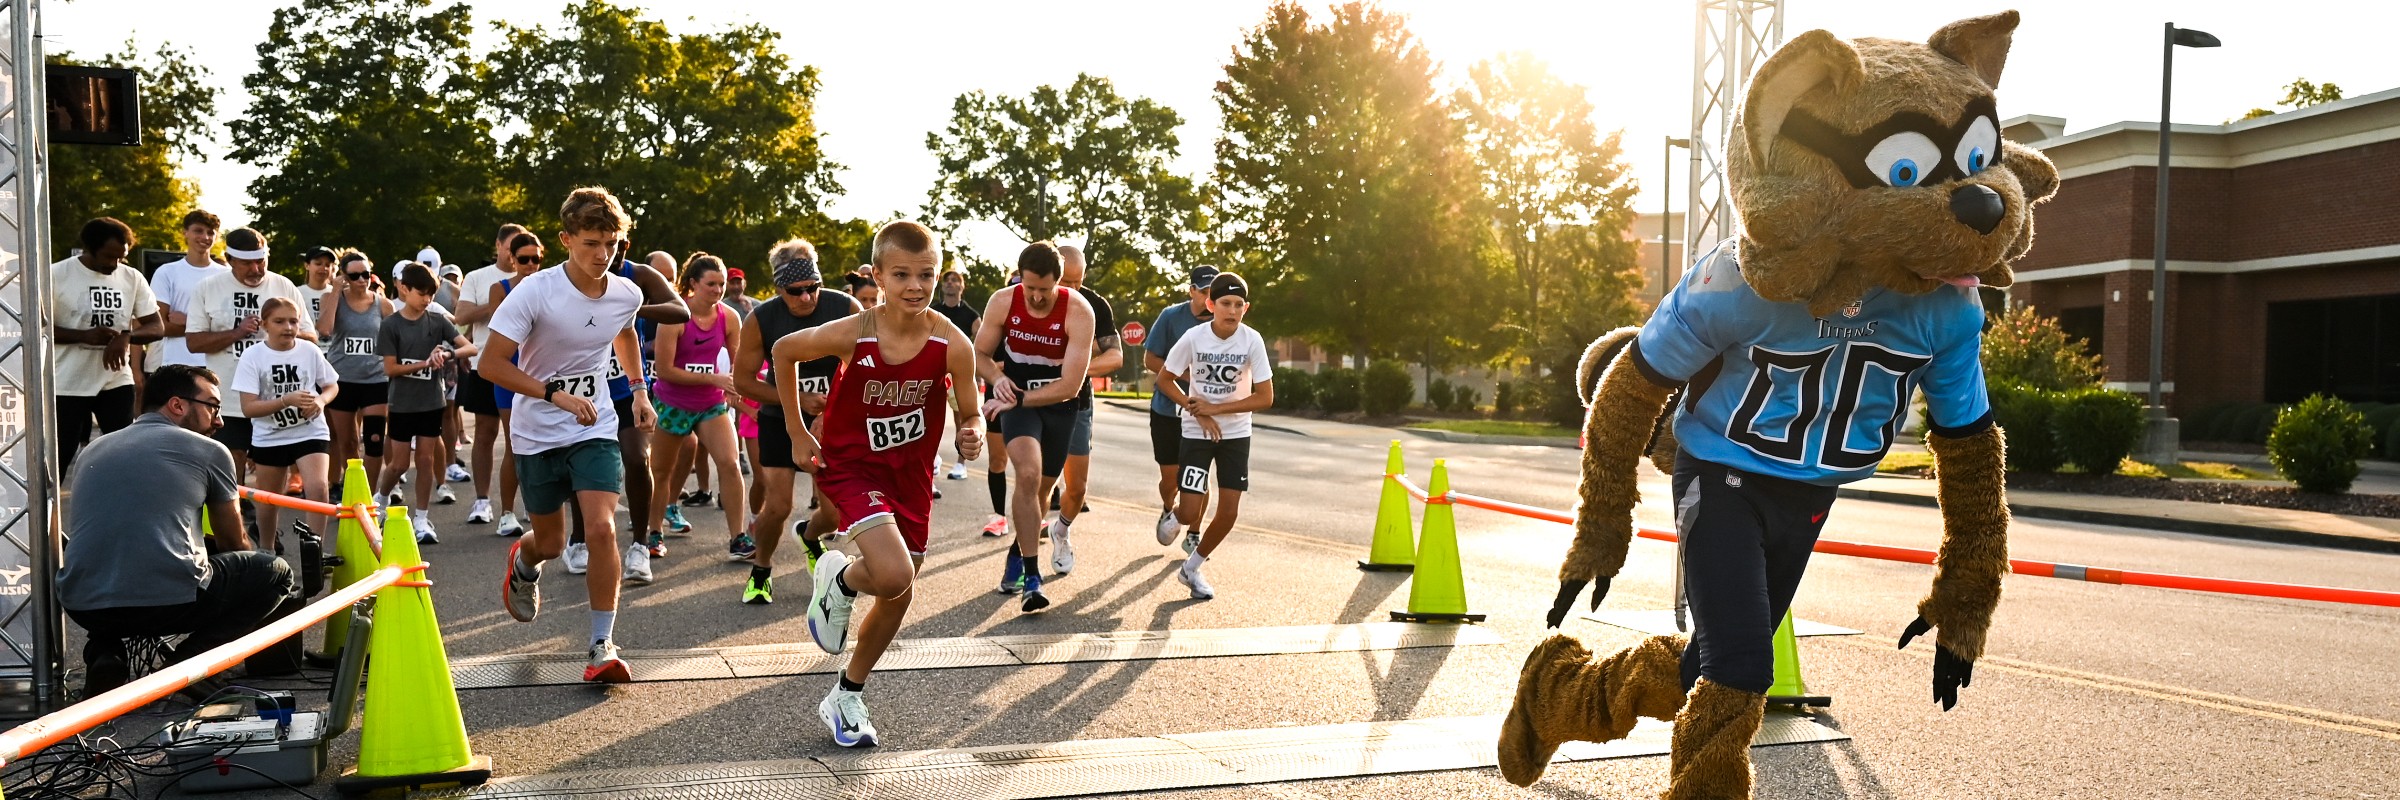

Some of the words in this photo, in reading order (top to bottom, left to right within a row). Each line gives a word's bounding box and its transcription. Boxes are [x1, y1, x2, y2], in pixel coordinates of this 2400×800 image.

[93, 292, 122, 308] 965
[1123, 328, 1144, 339] STOP
[1815, 317, 1879, 339] TITANS
[1009, 329, 1062, 346] STASHVILLE
[1196, 352, 1248, 364] THOMPSON'S
[1205, 364, 1238, 383] XC
[274, 384, 283, 394] TO
[284, 383, 301, 393] BEAT
[863, 379, 934, 407] PAGE
[1203, 385, 1237, 394] STATION
[1725, 341, 1933, 472] 00
[871, 413, 923, 448] 852
